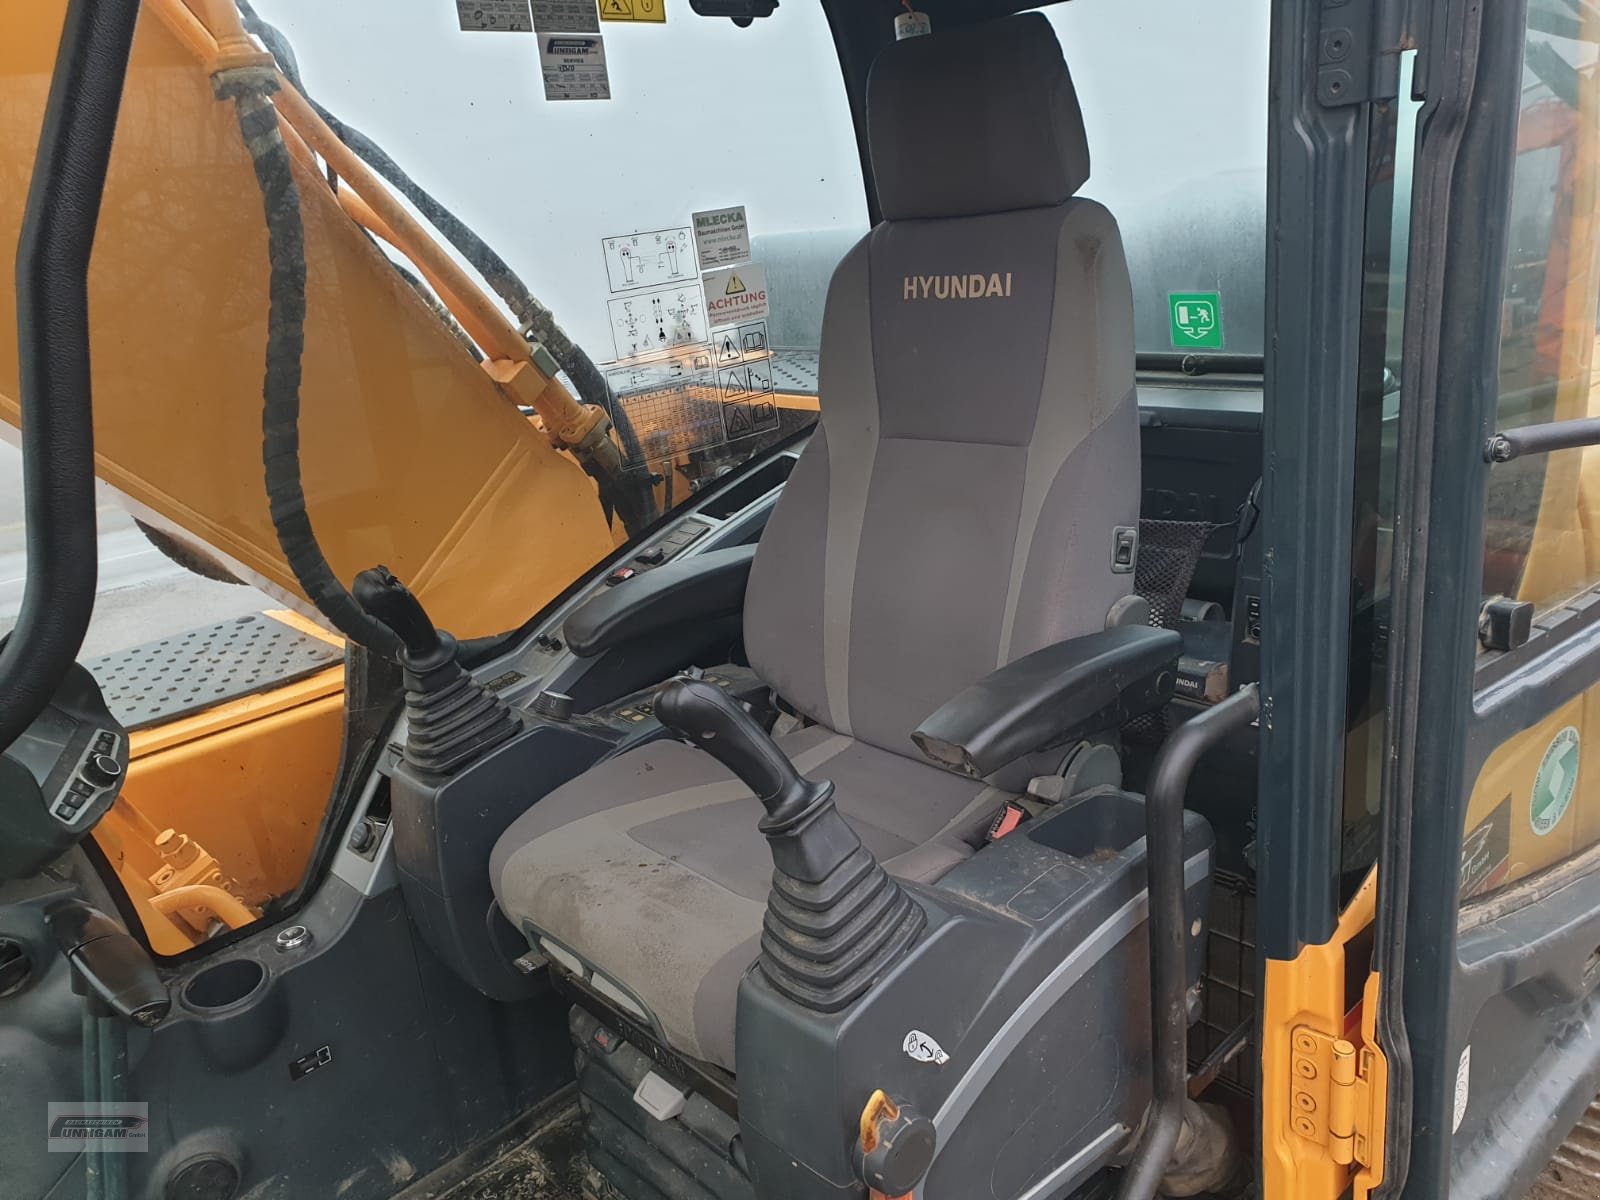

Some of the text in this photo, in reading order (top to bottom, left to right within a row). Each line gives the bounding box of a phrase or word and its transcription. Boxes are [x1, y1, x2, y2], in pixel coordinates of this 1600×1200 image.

[696, 211, 743, 228] MLECKA
[903, 272, 1012, 300] HYUNDAI
[708, 290, 766, 310] ACHTUNG
